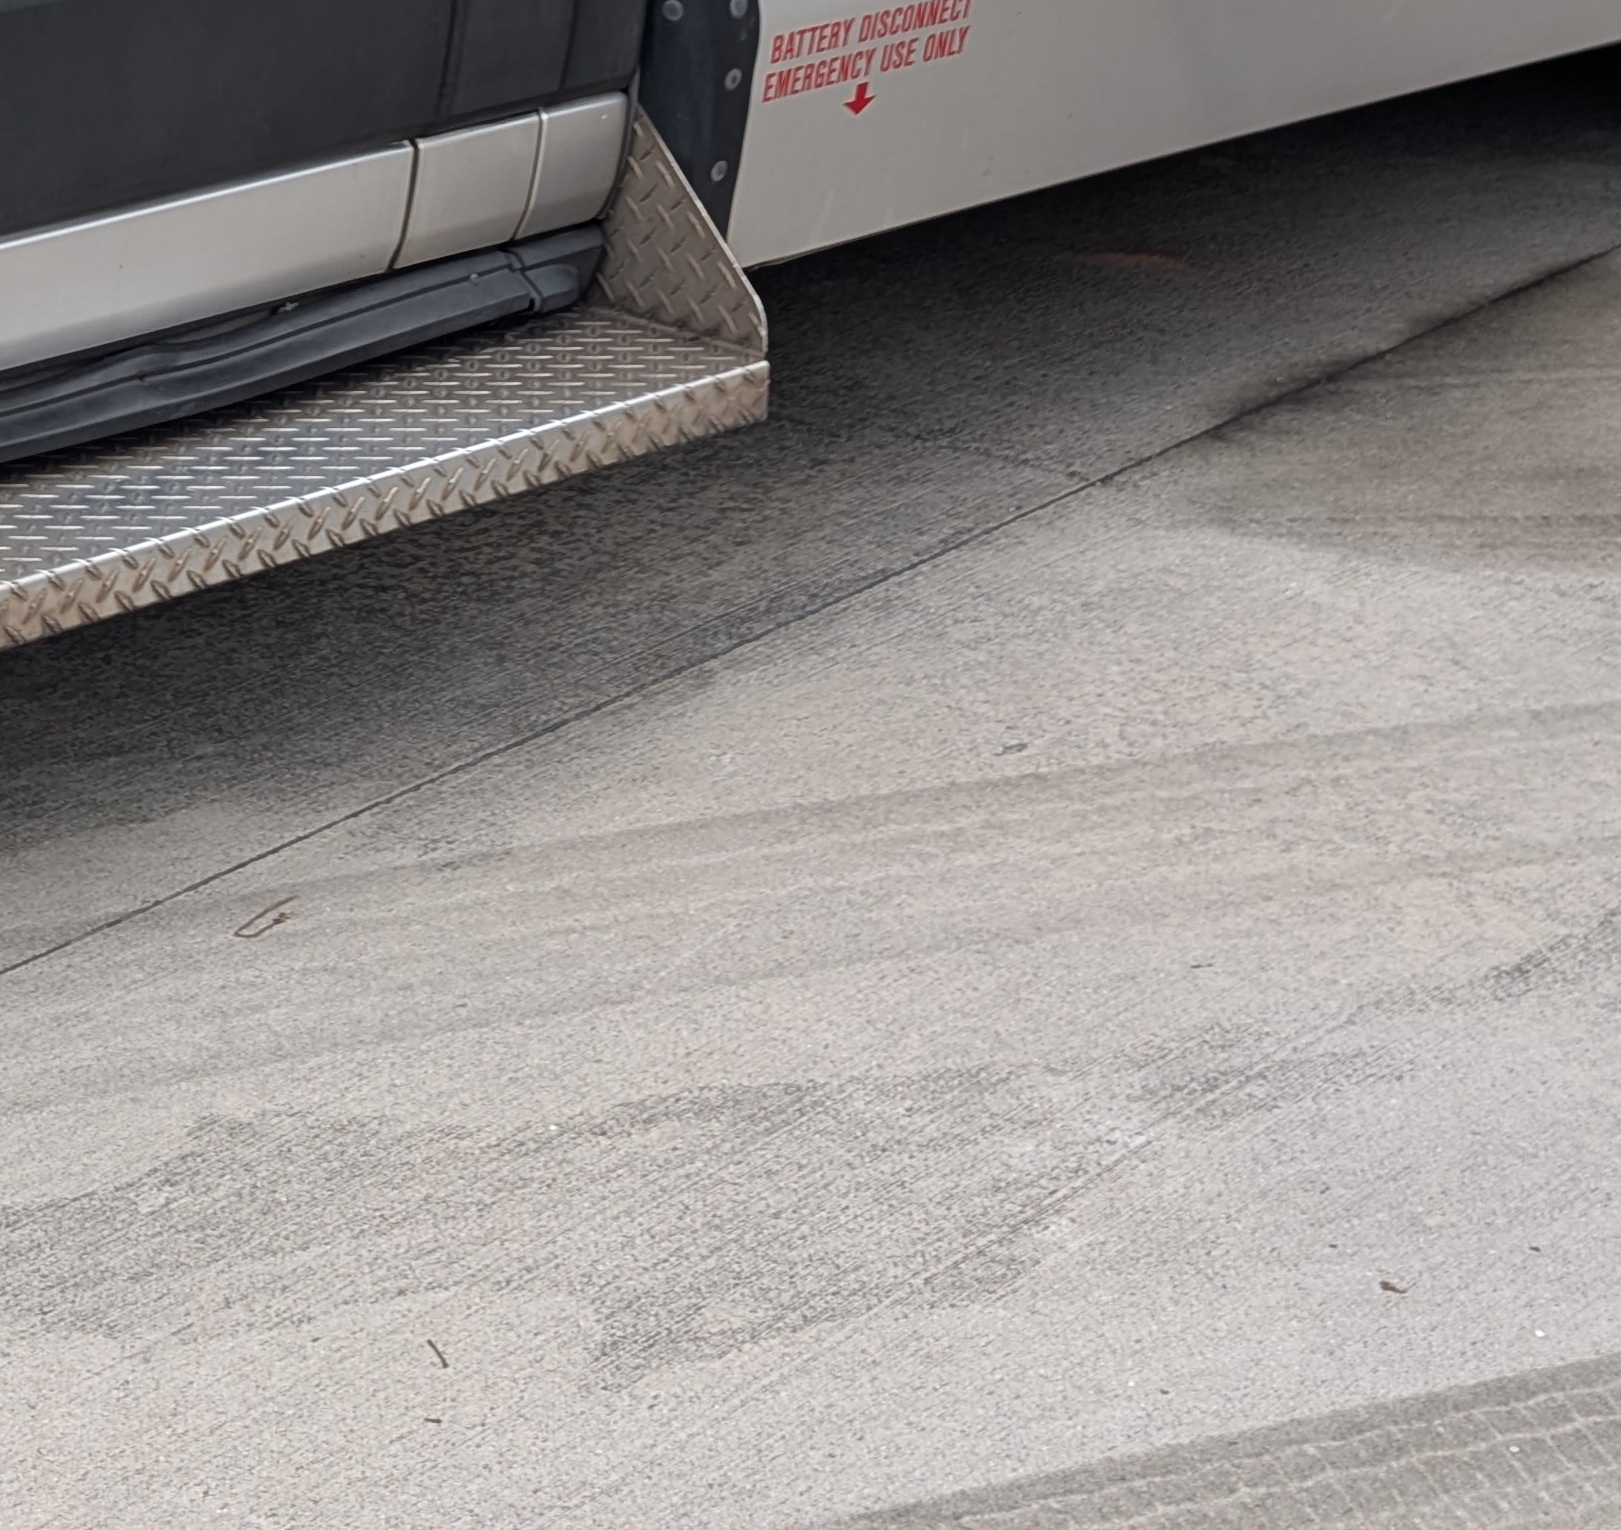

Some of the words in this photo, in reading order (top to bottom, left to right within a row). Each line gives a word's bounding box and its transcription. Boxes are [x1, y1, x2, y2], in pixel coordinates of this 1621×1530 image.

[762, 50, 873, 104] EMERGENCY
[879, 37, 917, 73] USE
[922, 25, 971, 63] ONLY
[770, 17, 855, 65] BATTERY
